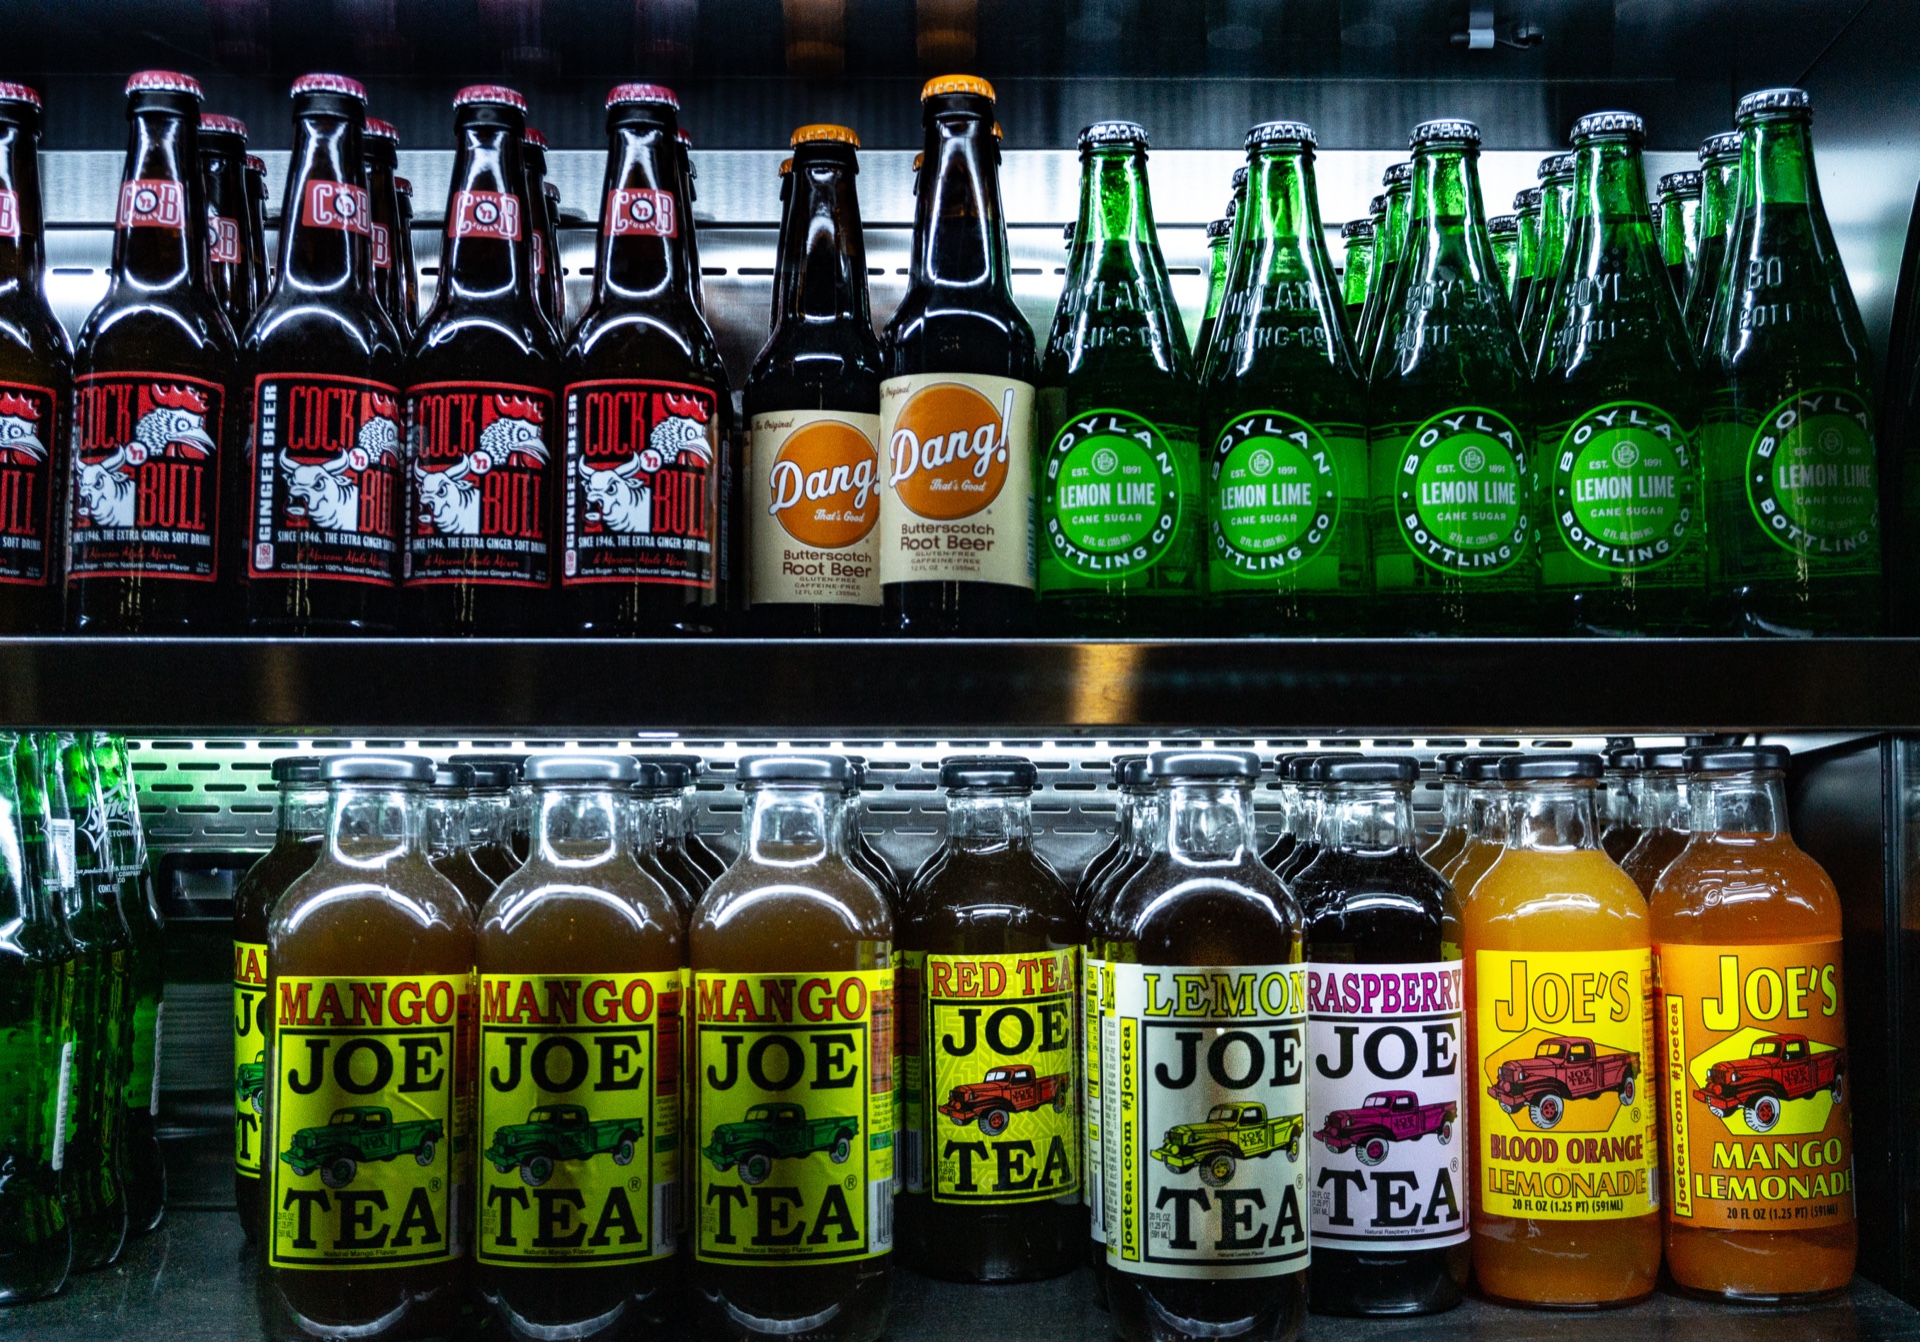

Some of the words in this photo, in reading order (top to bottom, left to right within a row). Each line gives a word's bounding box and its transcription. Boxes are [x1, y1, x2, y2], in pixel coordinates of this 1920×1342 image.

[159, 184, 182, 224] B
[313, 184, 332, 224] C
[357, 190, 370, 233] B
[456, 194, 473, 233] C
[499, 197, 518, 237] B
[476, 195, 497, 204] REAL
[612, 192, 629, 233] C
[655, 193, 673, 234] B
[631, 192, 653, 200] REAL
[472, 222, 500, 232] SUGAR
[628, 219, 655, 230] SUGAR
[80, 384, 134, 449] COCK
[262, 384, 277, 446] BEER
[288, 385, 357, 450] COCK
[419, 394, 478, 457] COCK
[567, 394, 578, 455] BEER
[586, 392, 648, 456] COCK
[889, 388, 1015, 489] Dang!
[1048, 417, 1173, 480] BOYLAN
[1212, 418, 1331, 481] BOYLAN
[1403, 414, 1527, 475] BOYLAN
[1559, 409, 1689, 472] BOYLAN
[930, 478, 958, 491] That's
[961, 479, 987, 492] Good
[1071, 467, 1089, 478] EST.
[1122, 465, 1142, 475] 1891
[1230, 468, 1246, 479] EST.
[1277, 466, 1297, 475] 1891
[1436, 465, 1456, 474] EST.
[1489, 464, 1505, 474] 1891
[1589, 461, 1609, 470] EST.
[1644, 459, 1662, 467] 1891
[1779, 464, 1837, 489] LEMON
[136, 462, 206, 530] BULL
[258, 452, 275, 541] GINGER
[482, 471, 543, 538] BULL
[566, 460, 576, 548] GINGER
[653, 470, 707, 538] BULL
[1060, 483, 1111, 509] LEMON
[1117, 482, 1156, 506] LIME
[1222, 484, 1266, 510] LEMON
[1272, 482, 1312, 506] LIME
[1422, 481, 1478, 506] LEMON
[1484, 481, 1516, 506] LIME
[1576, 475, 1632, 502] LEMON
[1638, 475, 1675, 498] LIME
[814, 509, 841, 521] That's
[844, 511, 865, 523] Good
[902, 523, 995, 535] Butterscotch
[1072, 514, 1100, 525] CANE
[1104, 513, 1142, 523] SUGAR
[1231, 515, 1256, 526] CANE
[1260, 513, 1297, 524] SUGAR
[1437, 512, 1467, 521] CANE
[1472, 512, 1507, 521] SUGAR
[1590, 507, 1621, 518] CANE
[1626, 507, 1664, 516] SUGAR
[1760, 498, 1868, 552] BOTTLING
[2, 536, 20, 549] SOFT
[103, 530, 115, 541] THE
[116, 530, 139, 541] EXTRA
[141, 530, 169, 543] GINGER
[171, 532, 189, 544] SOFT
[190, 534, 211, 547] DRINK
[278, 531, 297, 542] SINCE
[300, 531, 322, 543] 1946.
[325, 533, 337, 544] THE
[340, 534, 361, 547] EXTRA
[363, 536, 382, 548] GINGER
[413, 538, 425, 549] SINCE
[427, 538, 445, 548] 1946.
[447, 537, 459, 548] THE
[461, 537, 484, 548] EXTRA
[486, 537, 512, 549] GINGER
[515, 539, 529, 551] SOFT
[531, 541, 546, 553] DRINK
[578, 536, 594, 548] SINCE
[596, 536, 615, 547] 1946.
[617, 535, 630, 547] THE
[632, 535, 655, 547] EXTRA
[657, 536, 681, 549] GINGER
[683, 538, 696, 551] SOFT
[783, 550, 872, 562] Butterscotch
[900, 535, 941, 550] Root
[947, 535, 995, 551] Beer
[1049, 518, 1148, 569] BOTTLING
[1152, 514, 1172, 544] CO
[1213, 520, 1302, 570] BOTTLING
[1308, 514, 1329, 544] CO
[1405, 513, 1511, 567] BOTTLING
[1562, 510, 1669, 563] BOTTLING
[281, 562, 297, 570] Cane
[300, 563, 318, 571] Sugar
[344, 566, 365, 574] Natural
[636, 567, 659, 576] Natural
[661, 569, 680, 578] Ginger
[782, 562, 825, 575] Root
[831, 563, 872, 578] Beer
[931, 961, 1007, 998] RED
[1016, 955, 1073, 996] TEA
[1143, 971, 1305, 1017] LEMON
[1308, 970, 1462, 1014] RASPBERRY
[1495, 960, 1630, 1033] JOE'S
[1702, 955, 1838, 1031] JOE'S
[279, 982, 455, 1026] MANGO
[482, 979, 654, 1024] MANGO
[697, 976, 867, 1023] MANGO
[942, 1002, 1069, 1056] JOE
[1316, 1022, 1457, 1080] JOE
[1670, 1002, 1683, 1081] #joetea
[288, 1036, 445, 1095] JOE
[490, 1035, 644, 1093] JOE
[707, 1034, 858, 1091] JOE
[1121, 1025, 1135, 1111] #joetea
[1155, 1028, 1303, 1090] JOE
[1569, 1069, 1590, 1079] JOE
[1570, 1075, 1593, 1086] TEA
[943, 1135, 1073, 1192] TEA
[1490, 1133, 1559, 1164] BLOOD
[1566, 1133, 1643, 1164] ORANGE
[1673, 1089, 1690, 1213] joetea.com
[1712, 1137, 1843, 1170] MANGO
[1122, 1121, 1136, 1257] joetea.com
[1316, 1166, 1460, 1228] TEA
[1488, 1167, 1647, 1199] LEMONADE
[1695, 1168, 1852, 1200] LEMONADE
[283, 1187, 442, 1250] TEA
[487, 1185, 642, 1248] TEA
[705, 1184, 860, 1246] TEA
[1155, 1185, 1305, 1250] TEA
[1512, 1200, 1524, 1210] 20
[1525, 1200, 1533, 1211] FL
[1535, 1200, 1548, 1212] OZ
[1551, 1200, 1573, 1213] (1.25
[1575, 1200, 1589, 1213] PT)
[1592, 1199, 1624, 1213] (591ML)
[1727, 1208, 1738, 1219] 20
[1740, 1208, 1750, 1220] FL
[1753, 1208, 1767, 1221] OZ
[1769, 1207, 1792, 1221] (1.25
[1795, 1207, 1808, 1221] PT)
